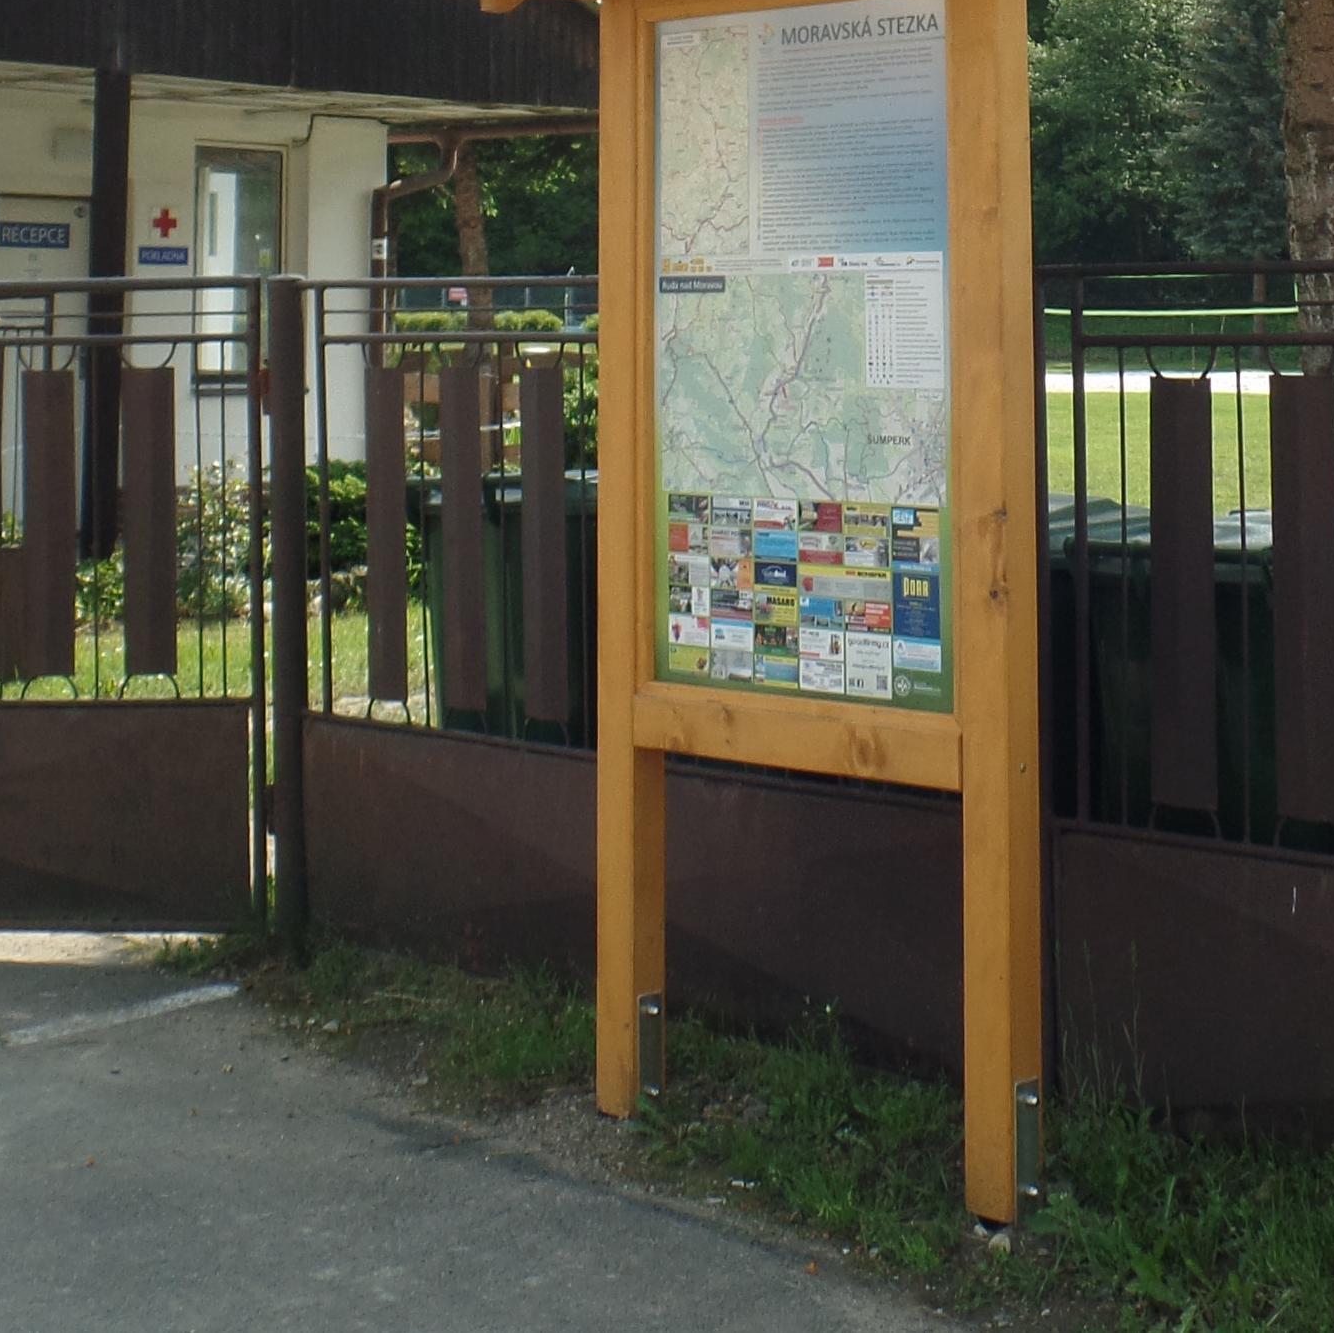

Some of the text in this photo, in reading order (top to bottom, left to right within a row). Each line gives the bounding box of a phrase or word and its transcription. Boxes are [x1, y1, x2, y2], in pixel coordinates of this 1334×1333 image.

[781, 13, 939, 46] MORAVSKÁ STEZKA
[1, 226, 66, 245] RECEPCE
[140, 250, 186, 263] POKLADNA
[680, 279, 693, 290] nad
